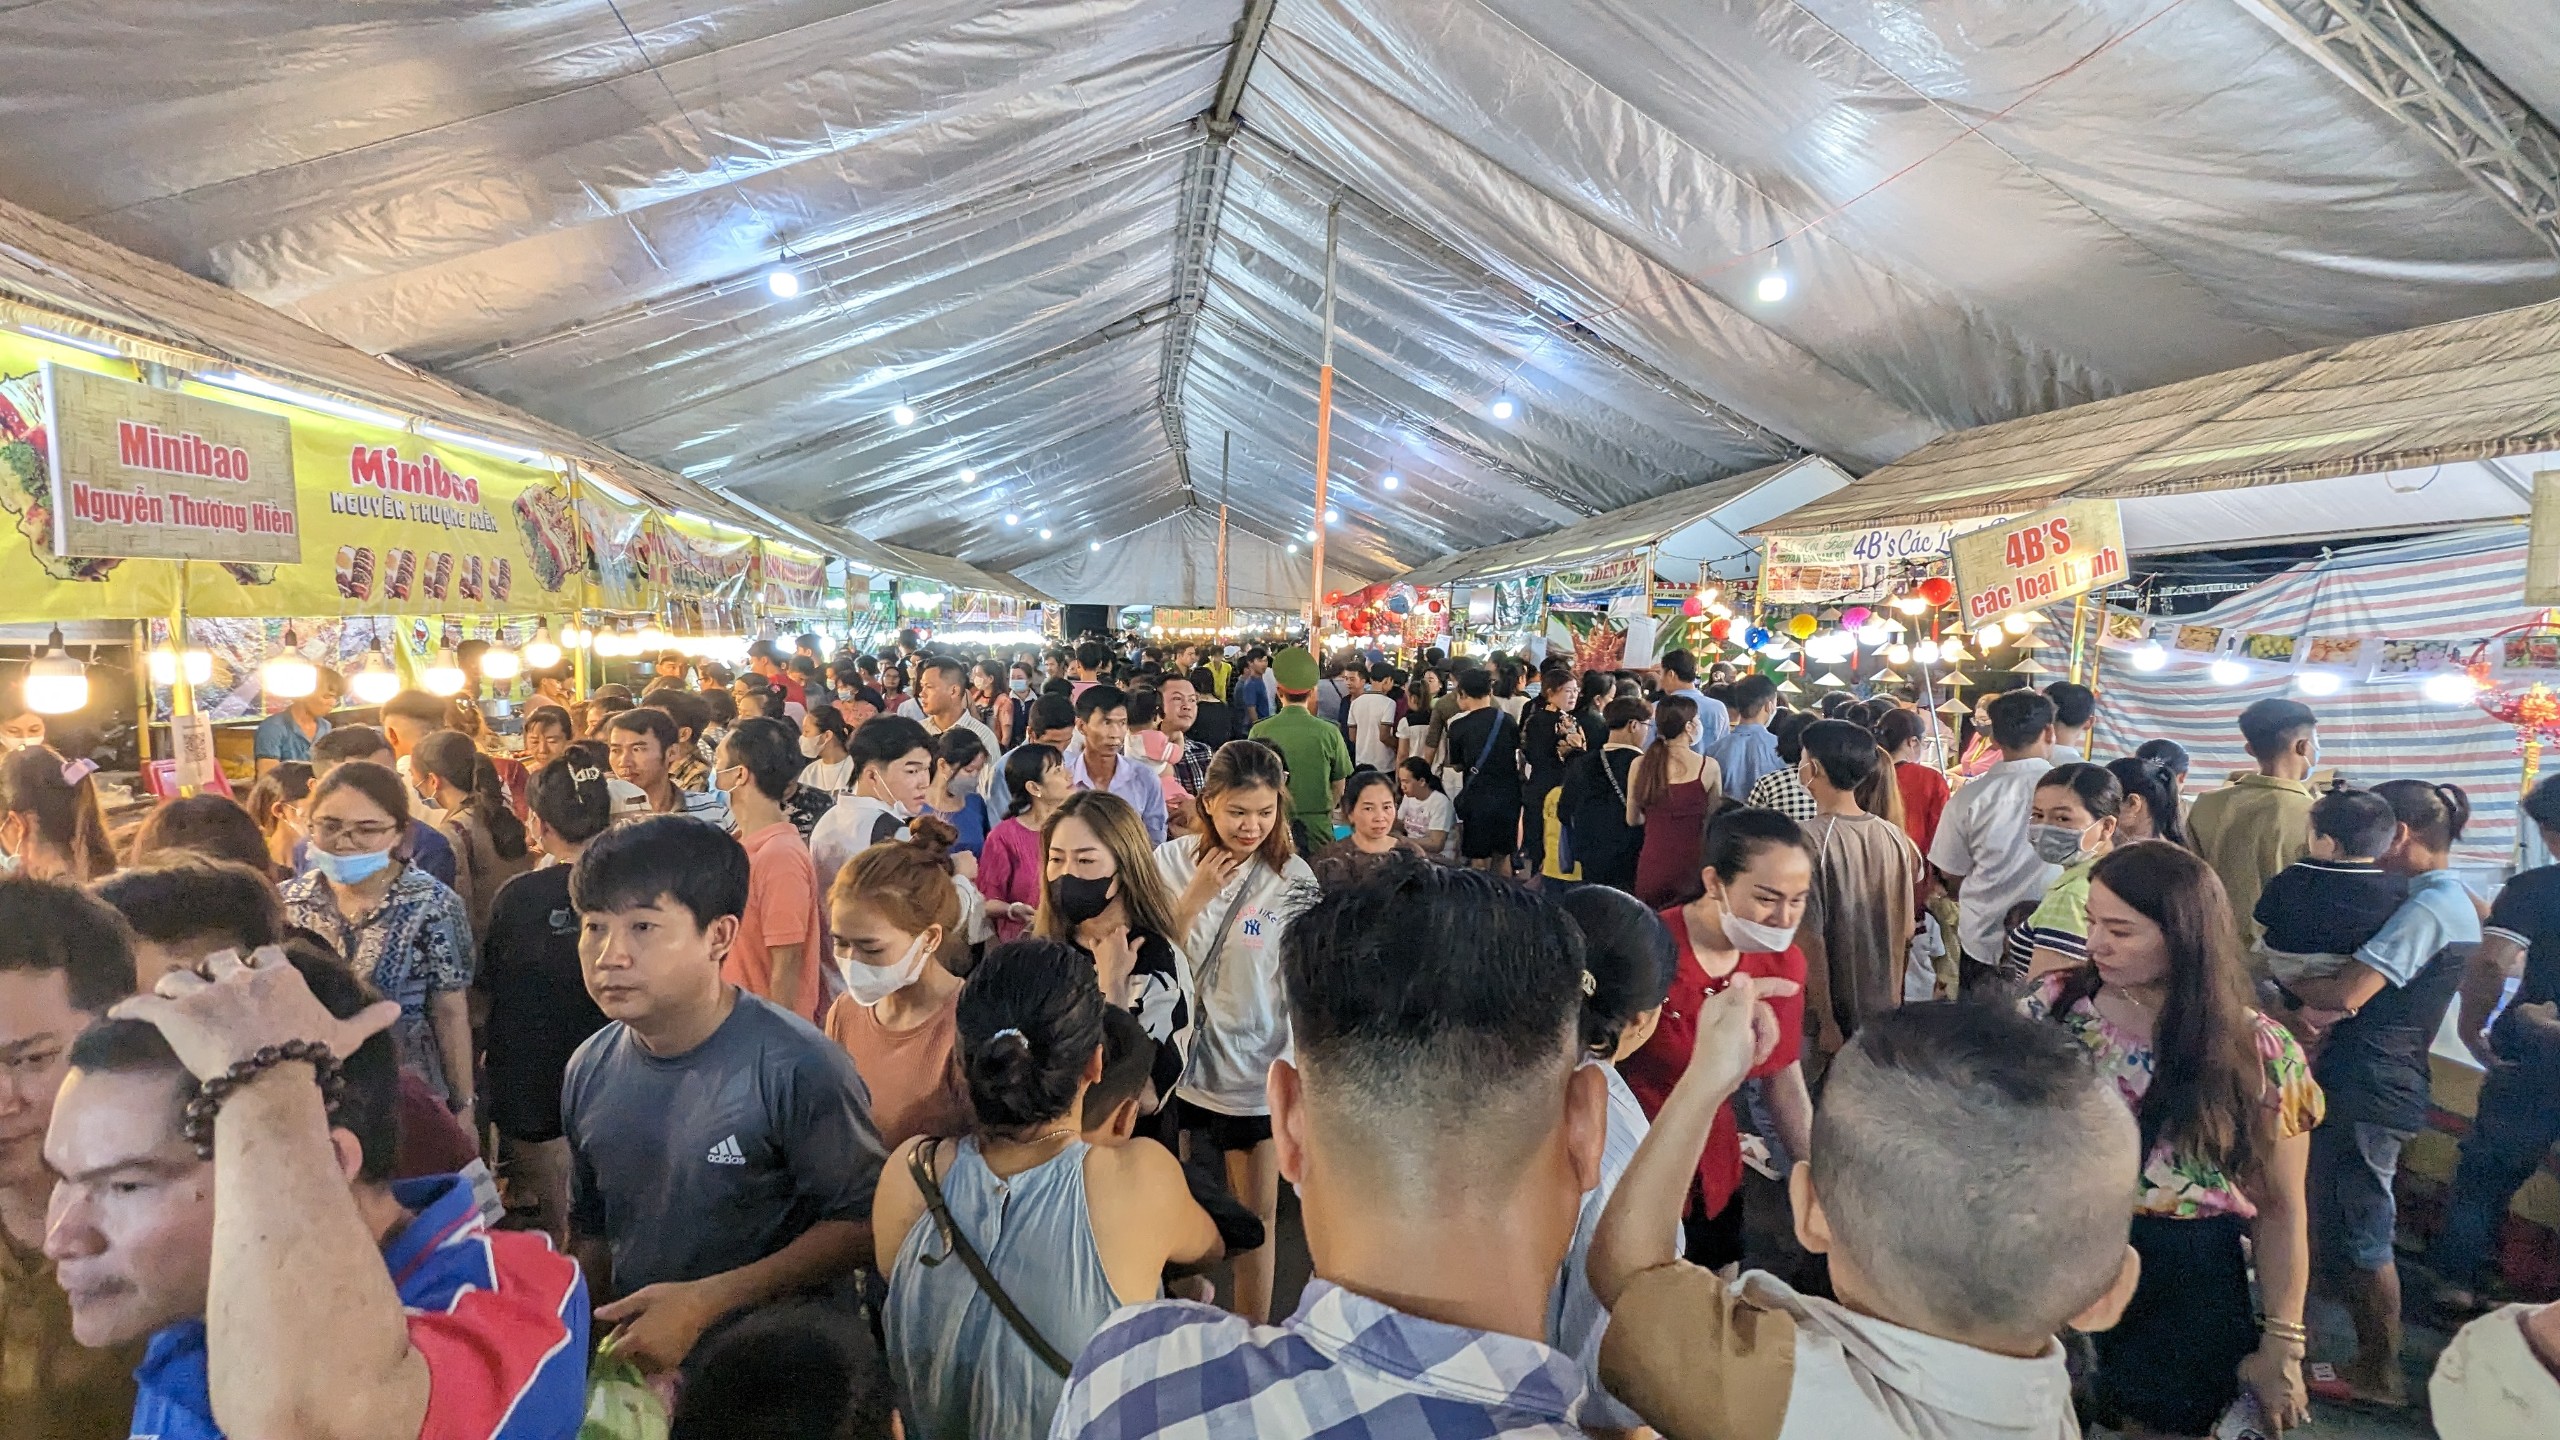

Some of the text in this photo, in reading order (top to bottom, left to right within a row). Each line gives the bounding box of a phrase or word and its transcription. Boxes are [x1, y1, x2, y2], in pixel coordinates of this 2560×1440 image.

[118, 421, 250, 482] Minibao
[351, 445, 480, 505] Minibao
[71, 483, 295, 535] Nguyễn Thượng Hiền
[1898, 528, 1934, 557] Các
[1970, 547, 2119, 618] các loại bánh
[707, 1153, 747, 1165] adidas
